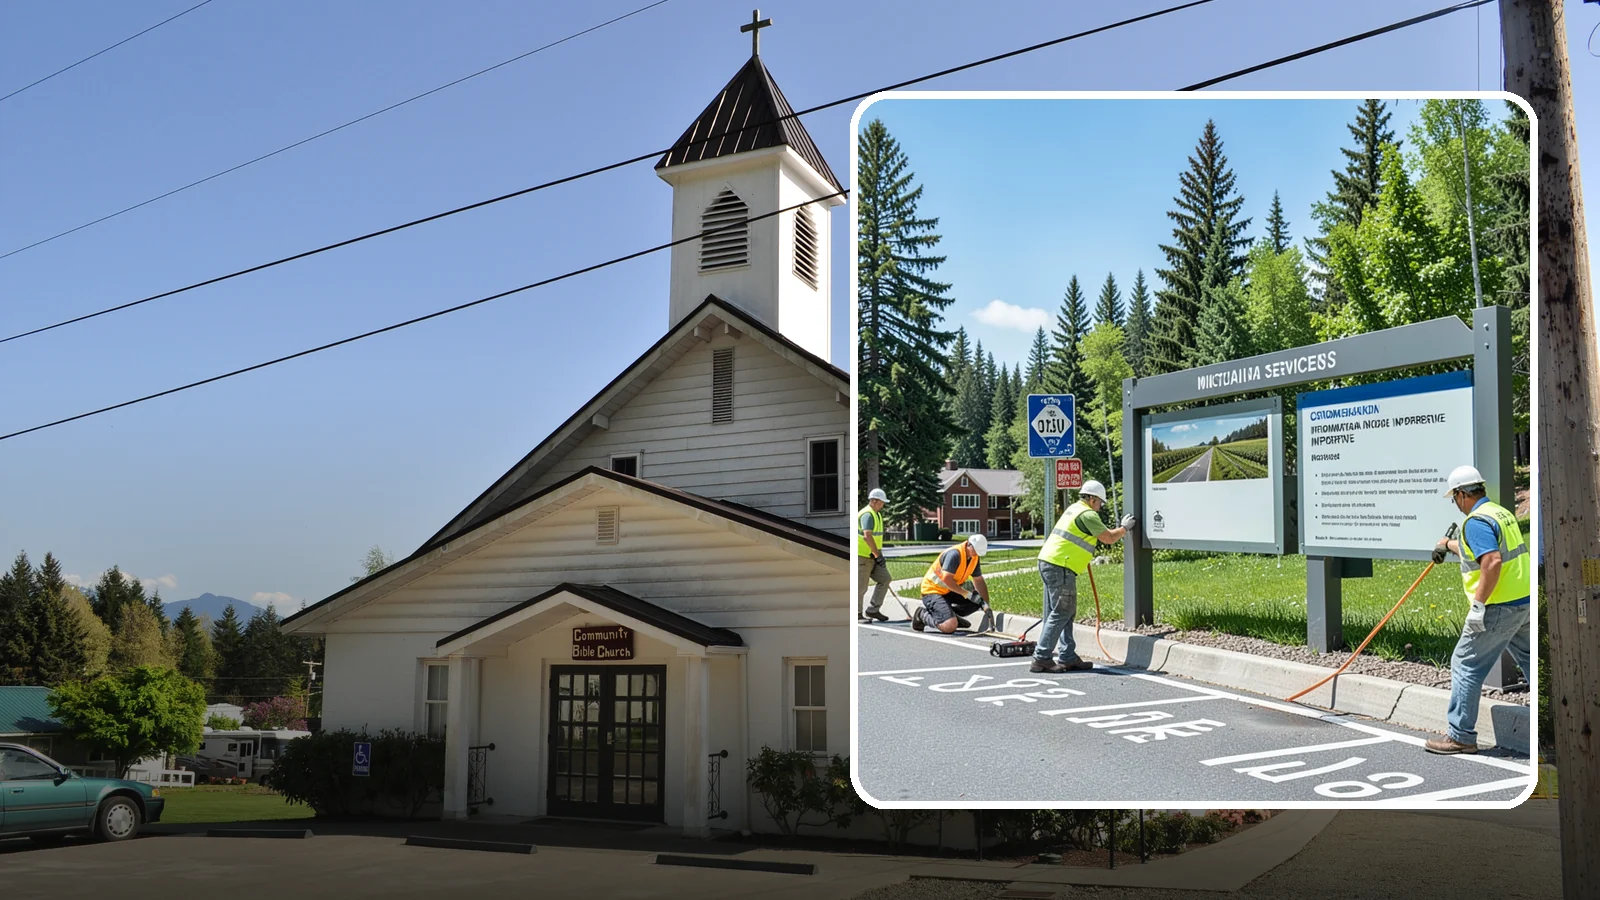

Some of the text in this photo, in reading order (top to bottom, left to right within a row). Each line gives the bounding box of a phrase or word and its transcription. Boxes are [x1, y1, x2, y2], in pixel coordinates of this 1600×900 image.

[574, 626, 629, 641] Community
[573, 645, 631, 658] Bible Church
